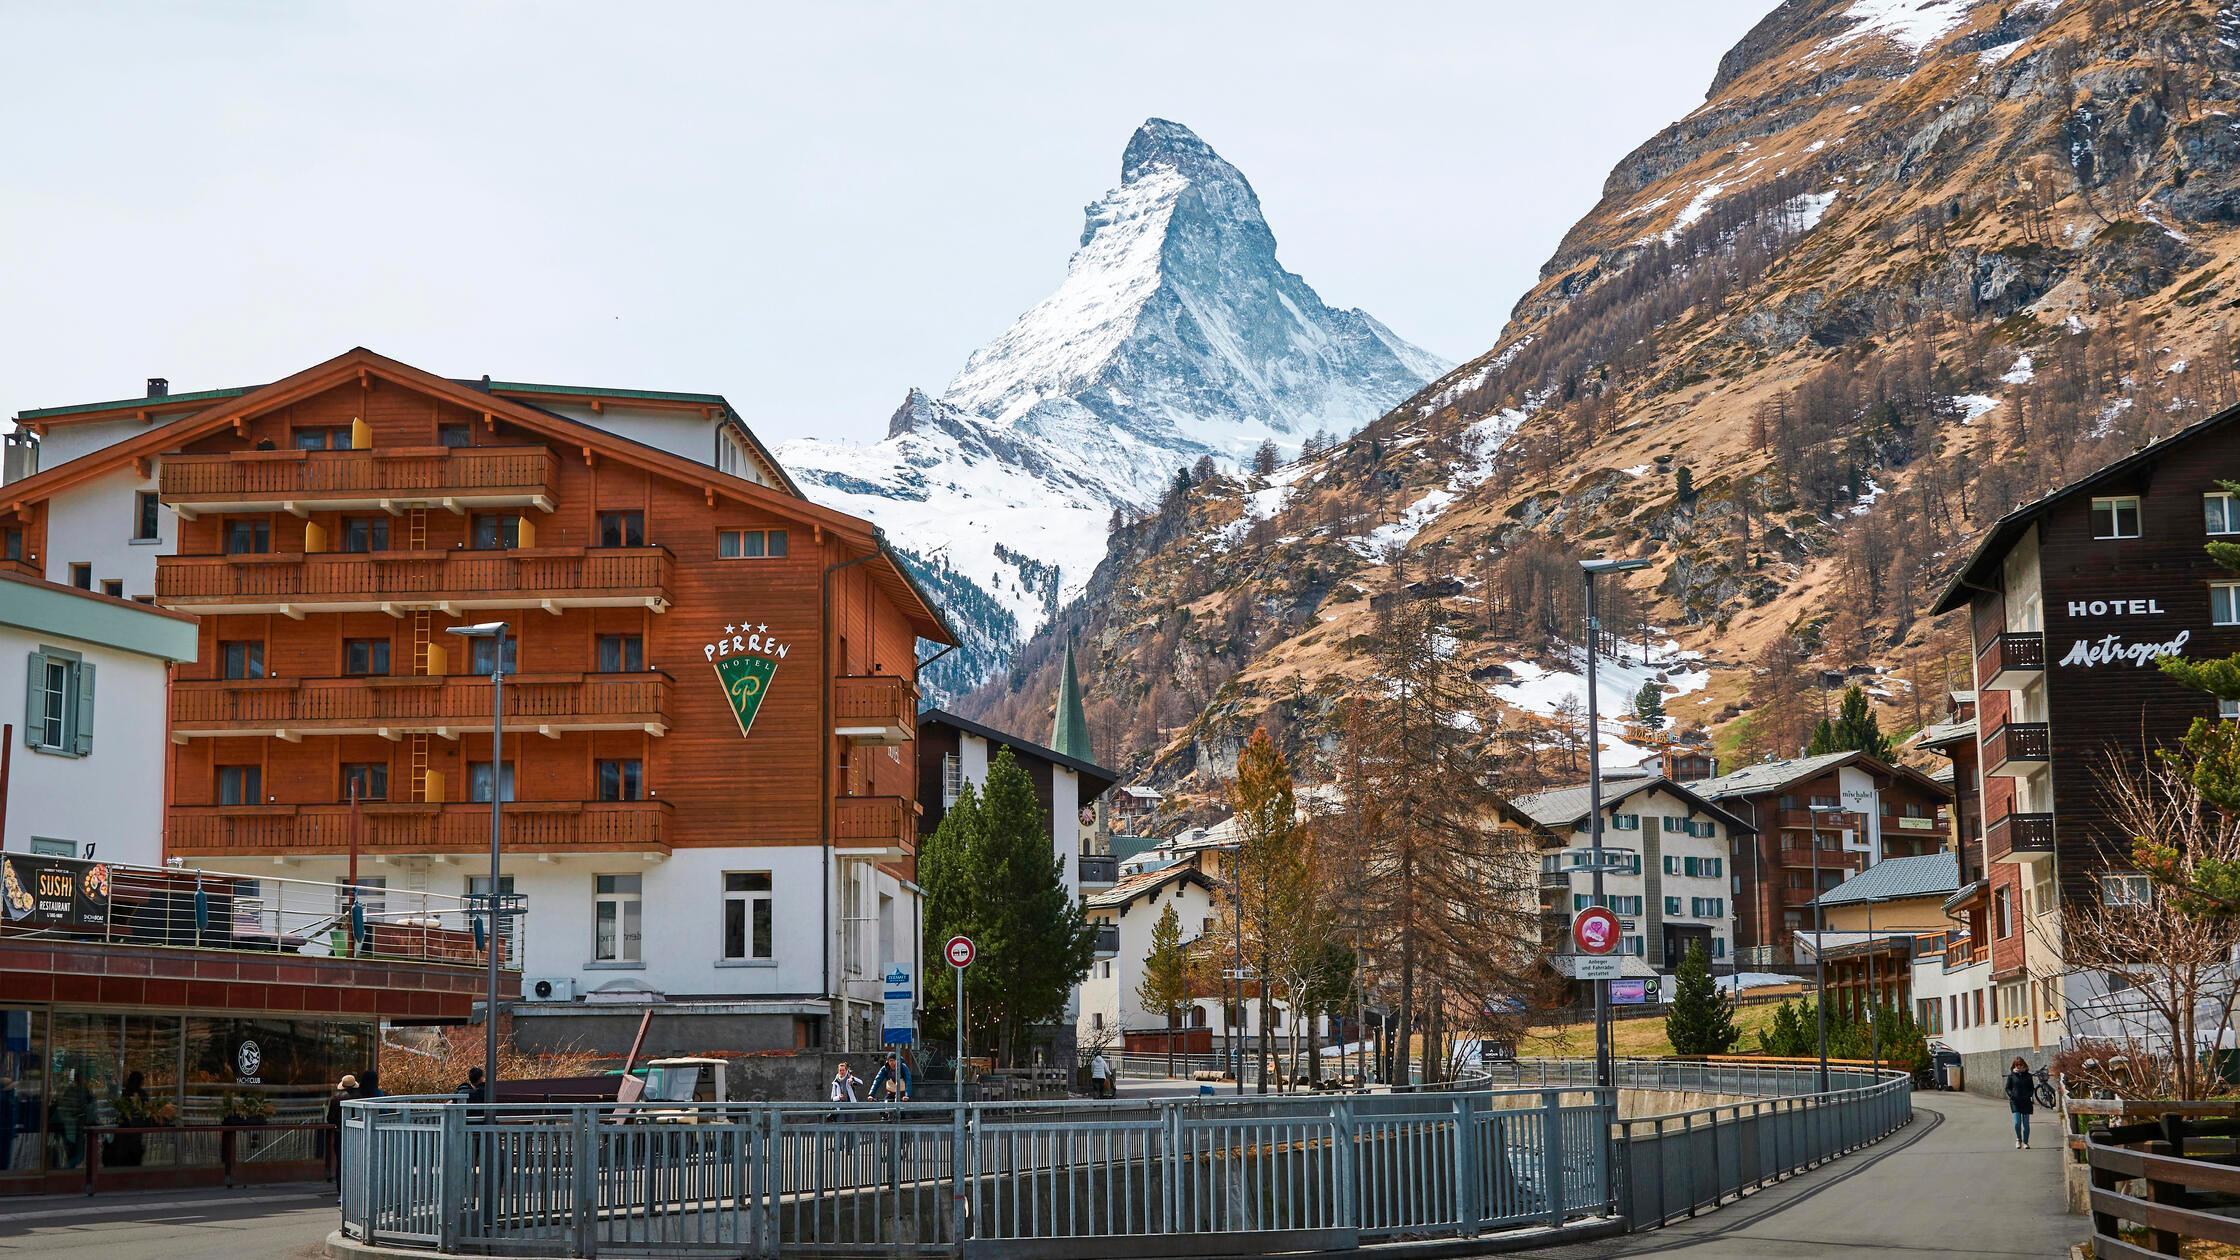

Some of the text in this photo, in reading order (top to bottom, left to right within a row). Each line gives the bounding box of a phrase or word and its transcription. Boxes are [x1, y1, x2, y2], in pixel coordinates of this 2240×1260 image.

[2068, 599, 2165, 617] HOTEL
[703, 633, 792, 662] PERREN
[2058, 629, 2191, 668] Metropol
[722, 658, 770, 671] HOTEL
[1842, 790, 1873, 799] mischabel
[39, 874, 73, 897] SUSHI
[39, 900, 71, 912] RESTAURANT
